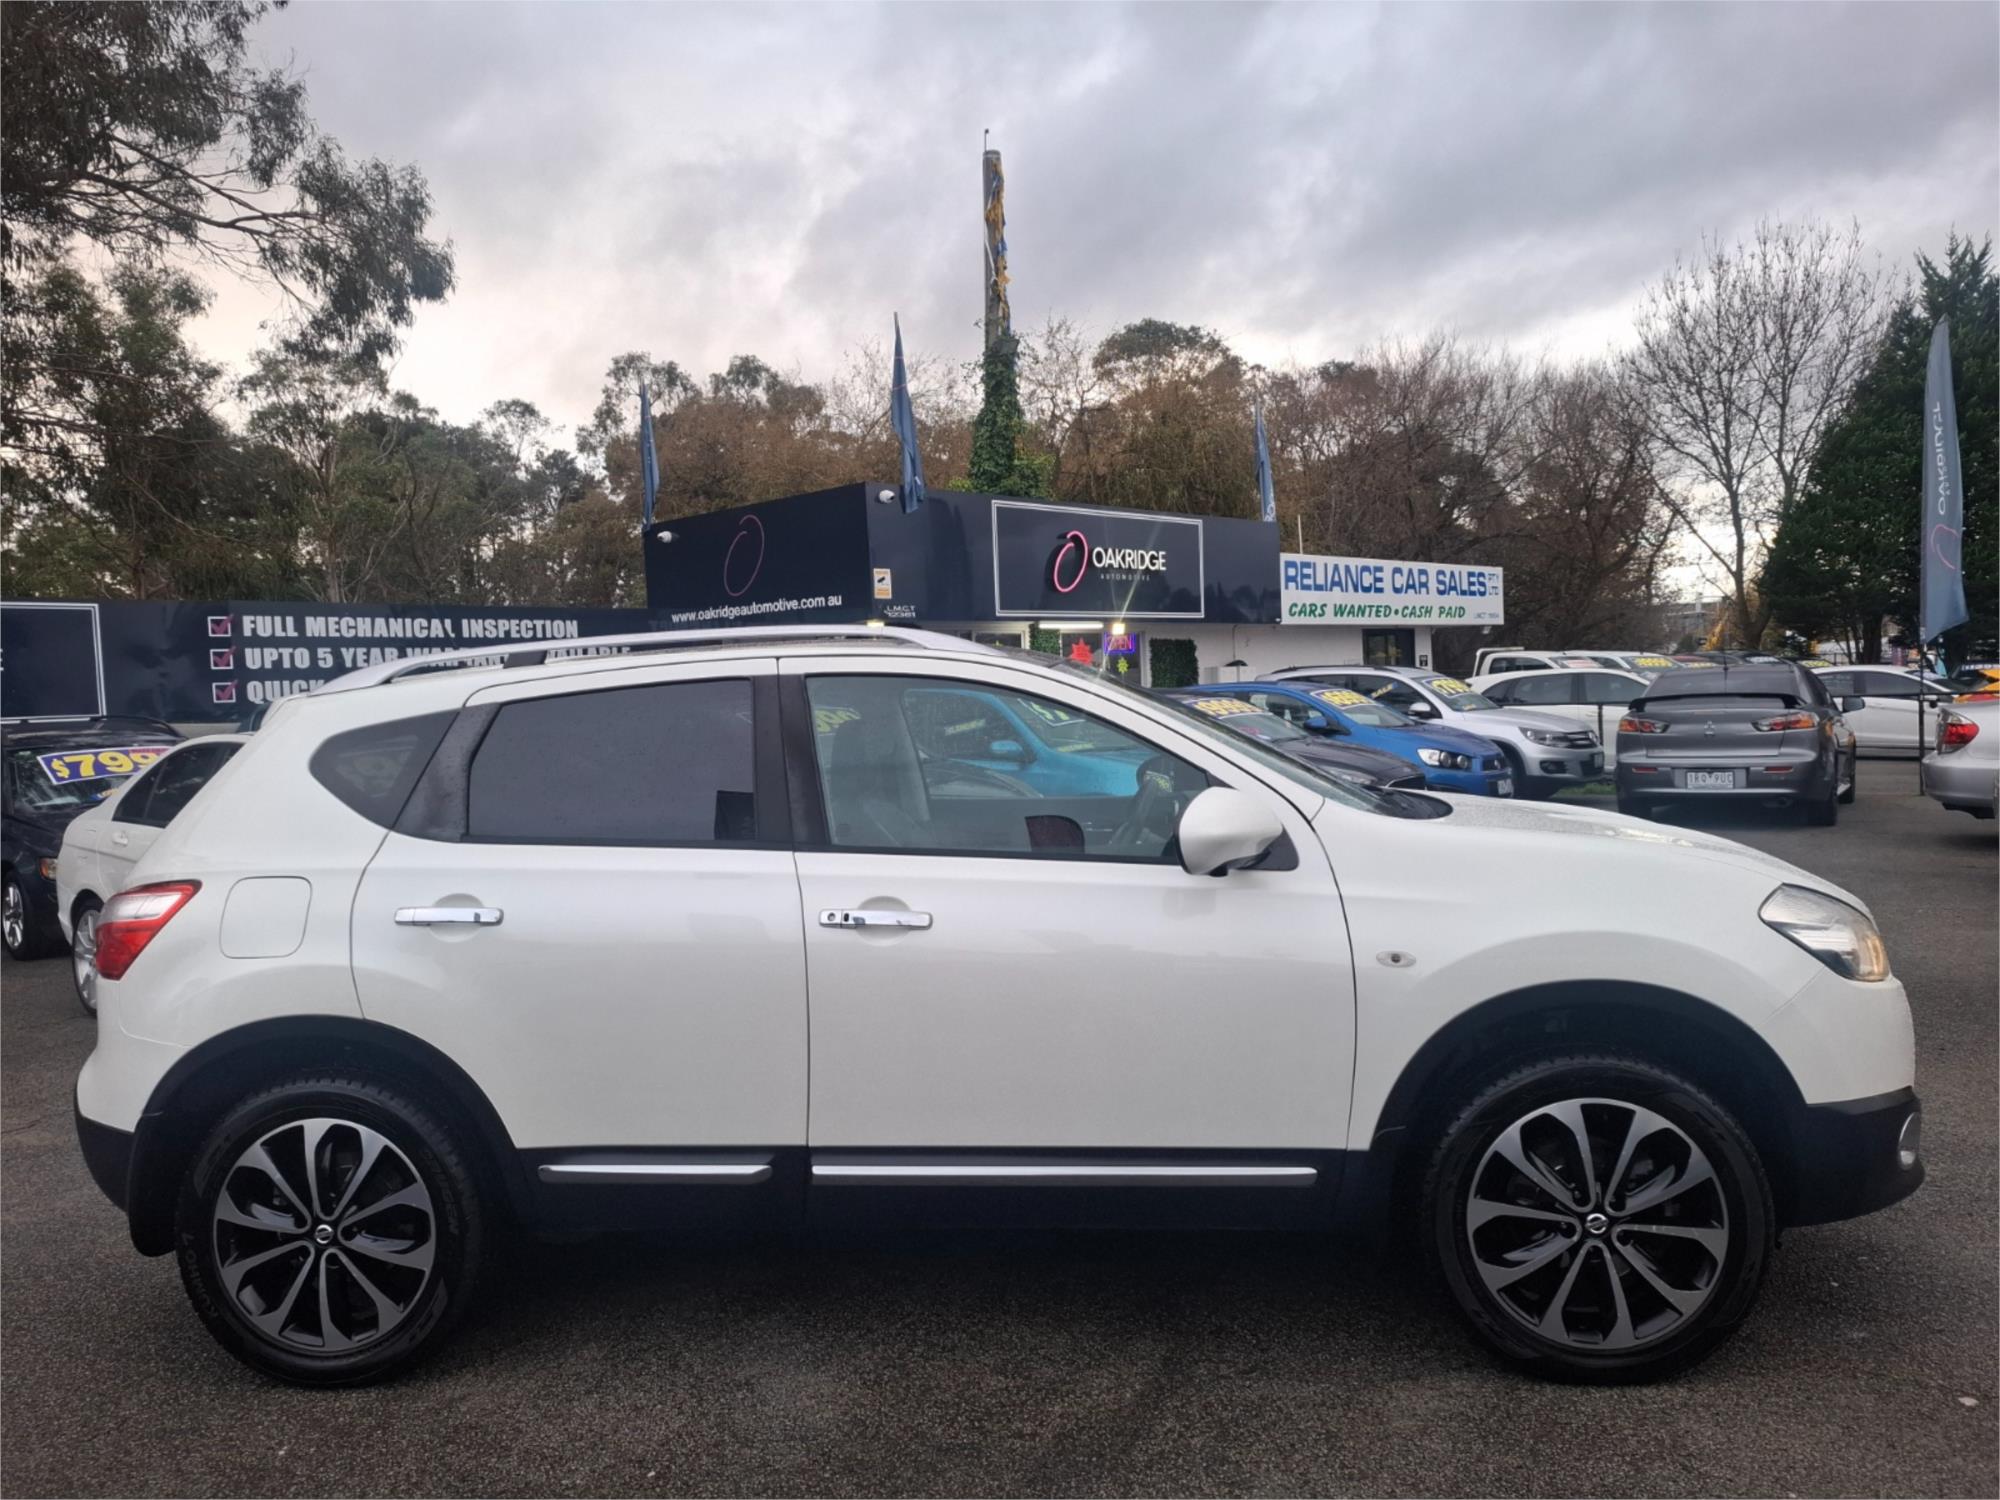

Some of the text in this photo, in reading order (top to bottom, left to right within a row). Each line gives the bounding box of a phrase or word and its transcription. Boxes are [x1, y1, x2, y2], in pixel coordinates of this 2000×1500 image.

[1092, 547, 1167, 571] OAKRIDGE
[1284, 560, 1487, 597] RELIANCE CAR SALES
[1288, 603, 1466, 619] CARS WANTED CASH PAID
[243, 615, 579, 639] FULL MECHANICAL INSPECTION
[244, 647, 311, 669] UPTO
[317, 647, 334, 668] 5
[340, 647, 400, 668] YEAR
